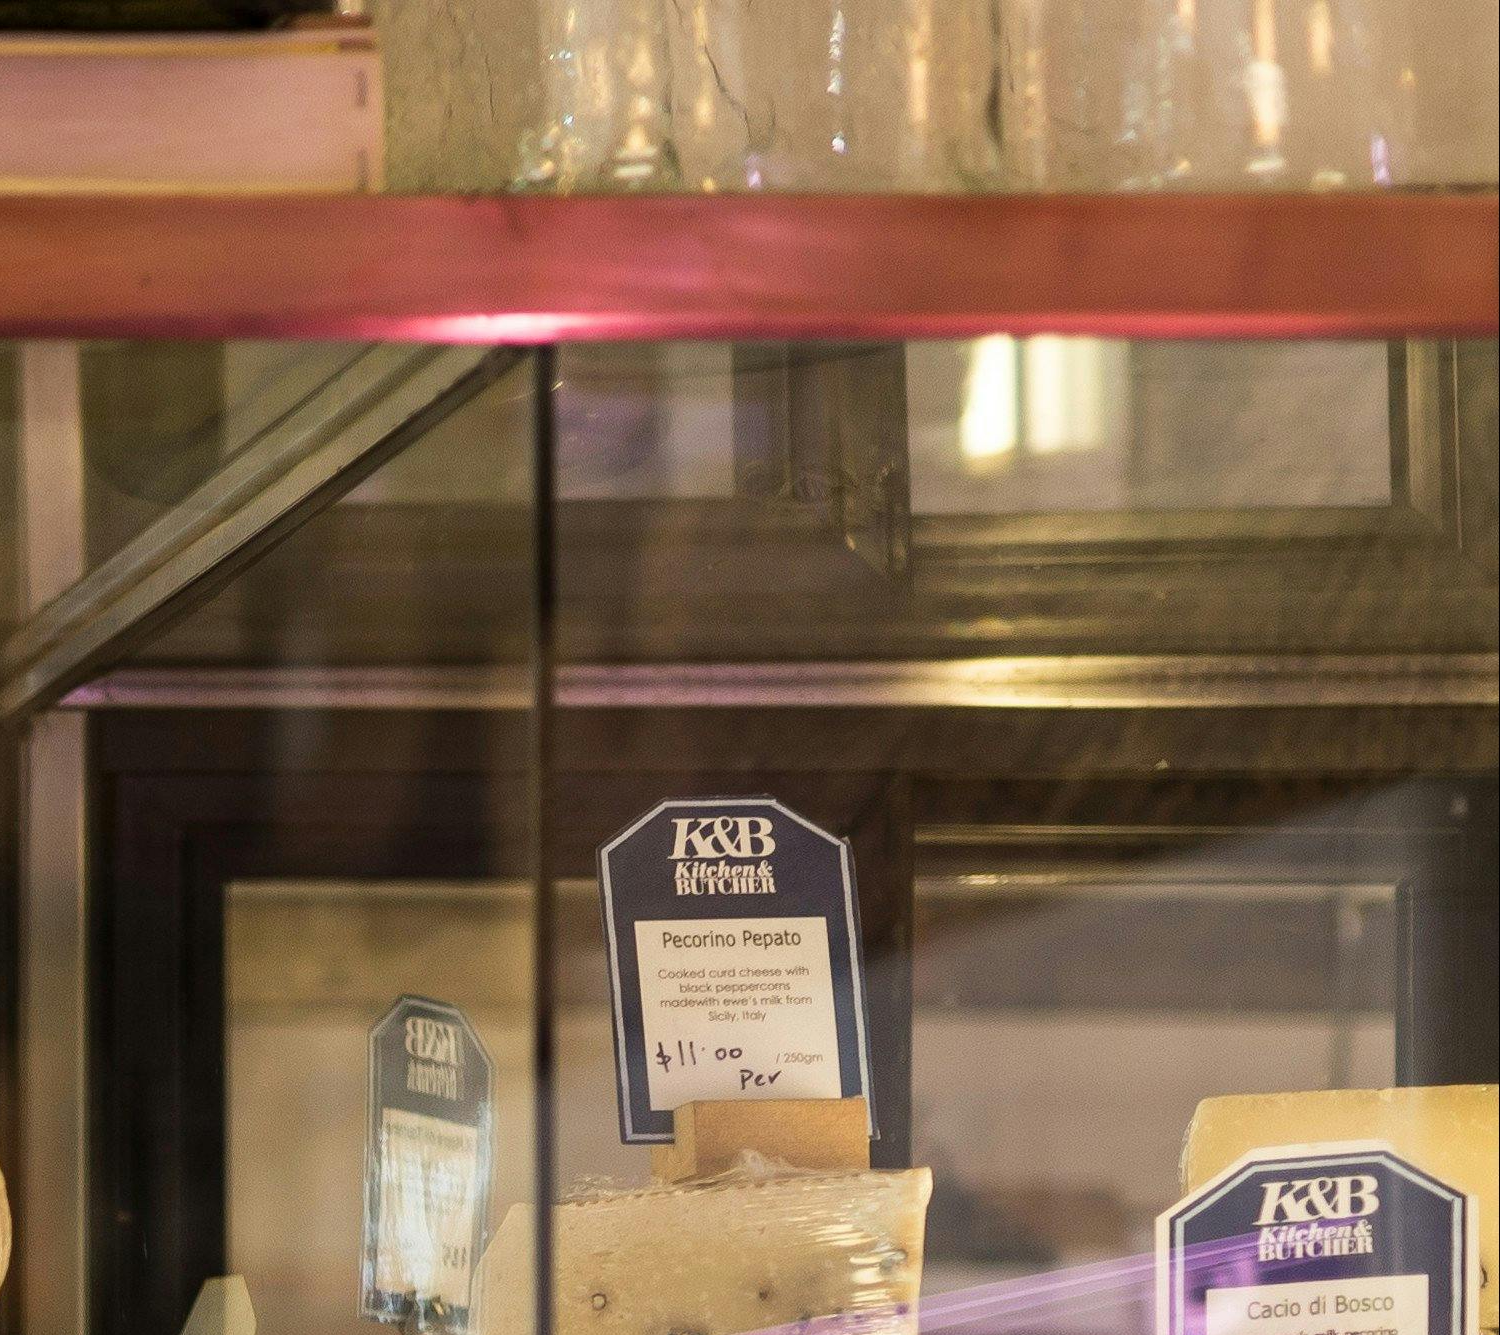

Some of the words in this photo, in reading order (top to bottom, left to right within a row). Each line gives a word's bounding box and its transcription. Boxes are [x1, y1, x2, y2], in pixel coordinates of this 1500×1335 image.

[667, 814, 777, 861] K&B
[675, 860, 773, 881] Kitchen&
[676, 876, 777, 896] BUTCHER
[663, 931, 736, 949] Pecorino
[743, 929, 802, 949] Pepato
[1251, 1175, 1380, 1226] K&B
[1247, 1300, 1301, 1321] Cacio
[1309, 1295, 1327, 1315] di
[1335, 1294, 1395, 1314] Bosco
